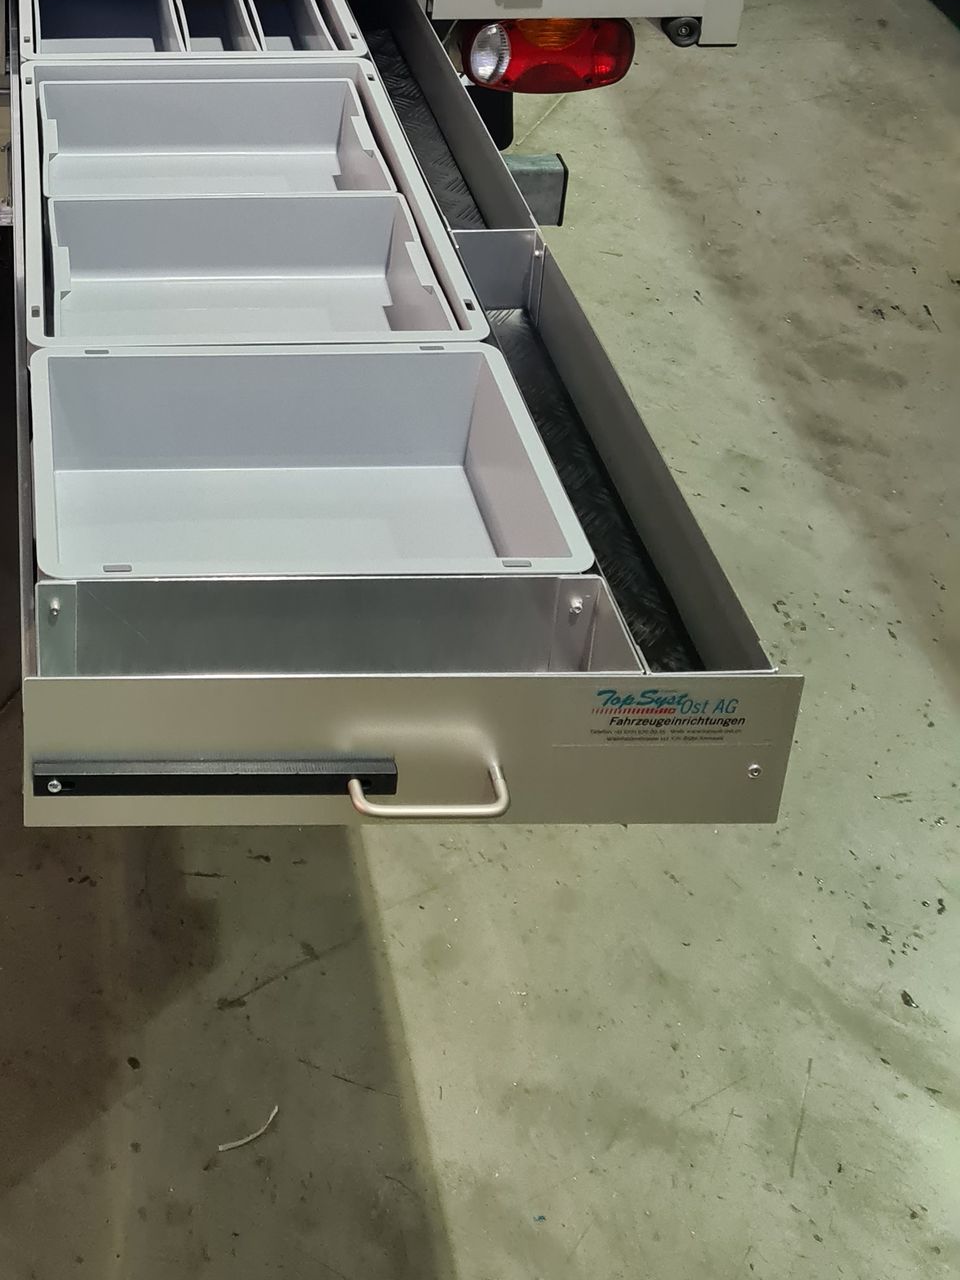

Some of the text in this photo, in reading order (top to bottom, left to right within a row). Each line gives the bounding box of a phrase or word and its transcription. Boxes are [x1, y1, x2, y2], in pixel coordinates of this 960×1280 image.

[597, 688, 739, 714] TopSyst Ost AG
[609, 716, 746, 727] Fahrzeugeinrichtungen
